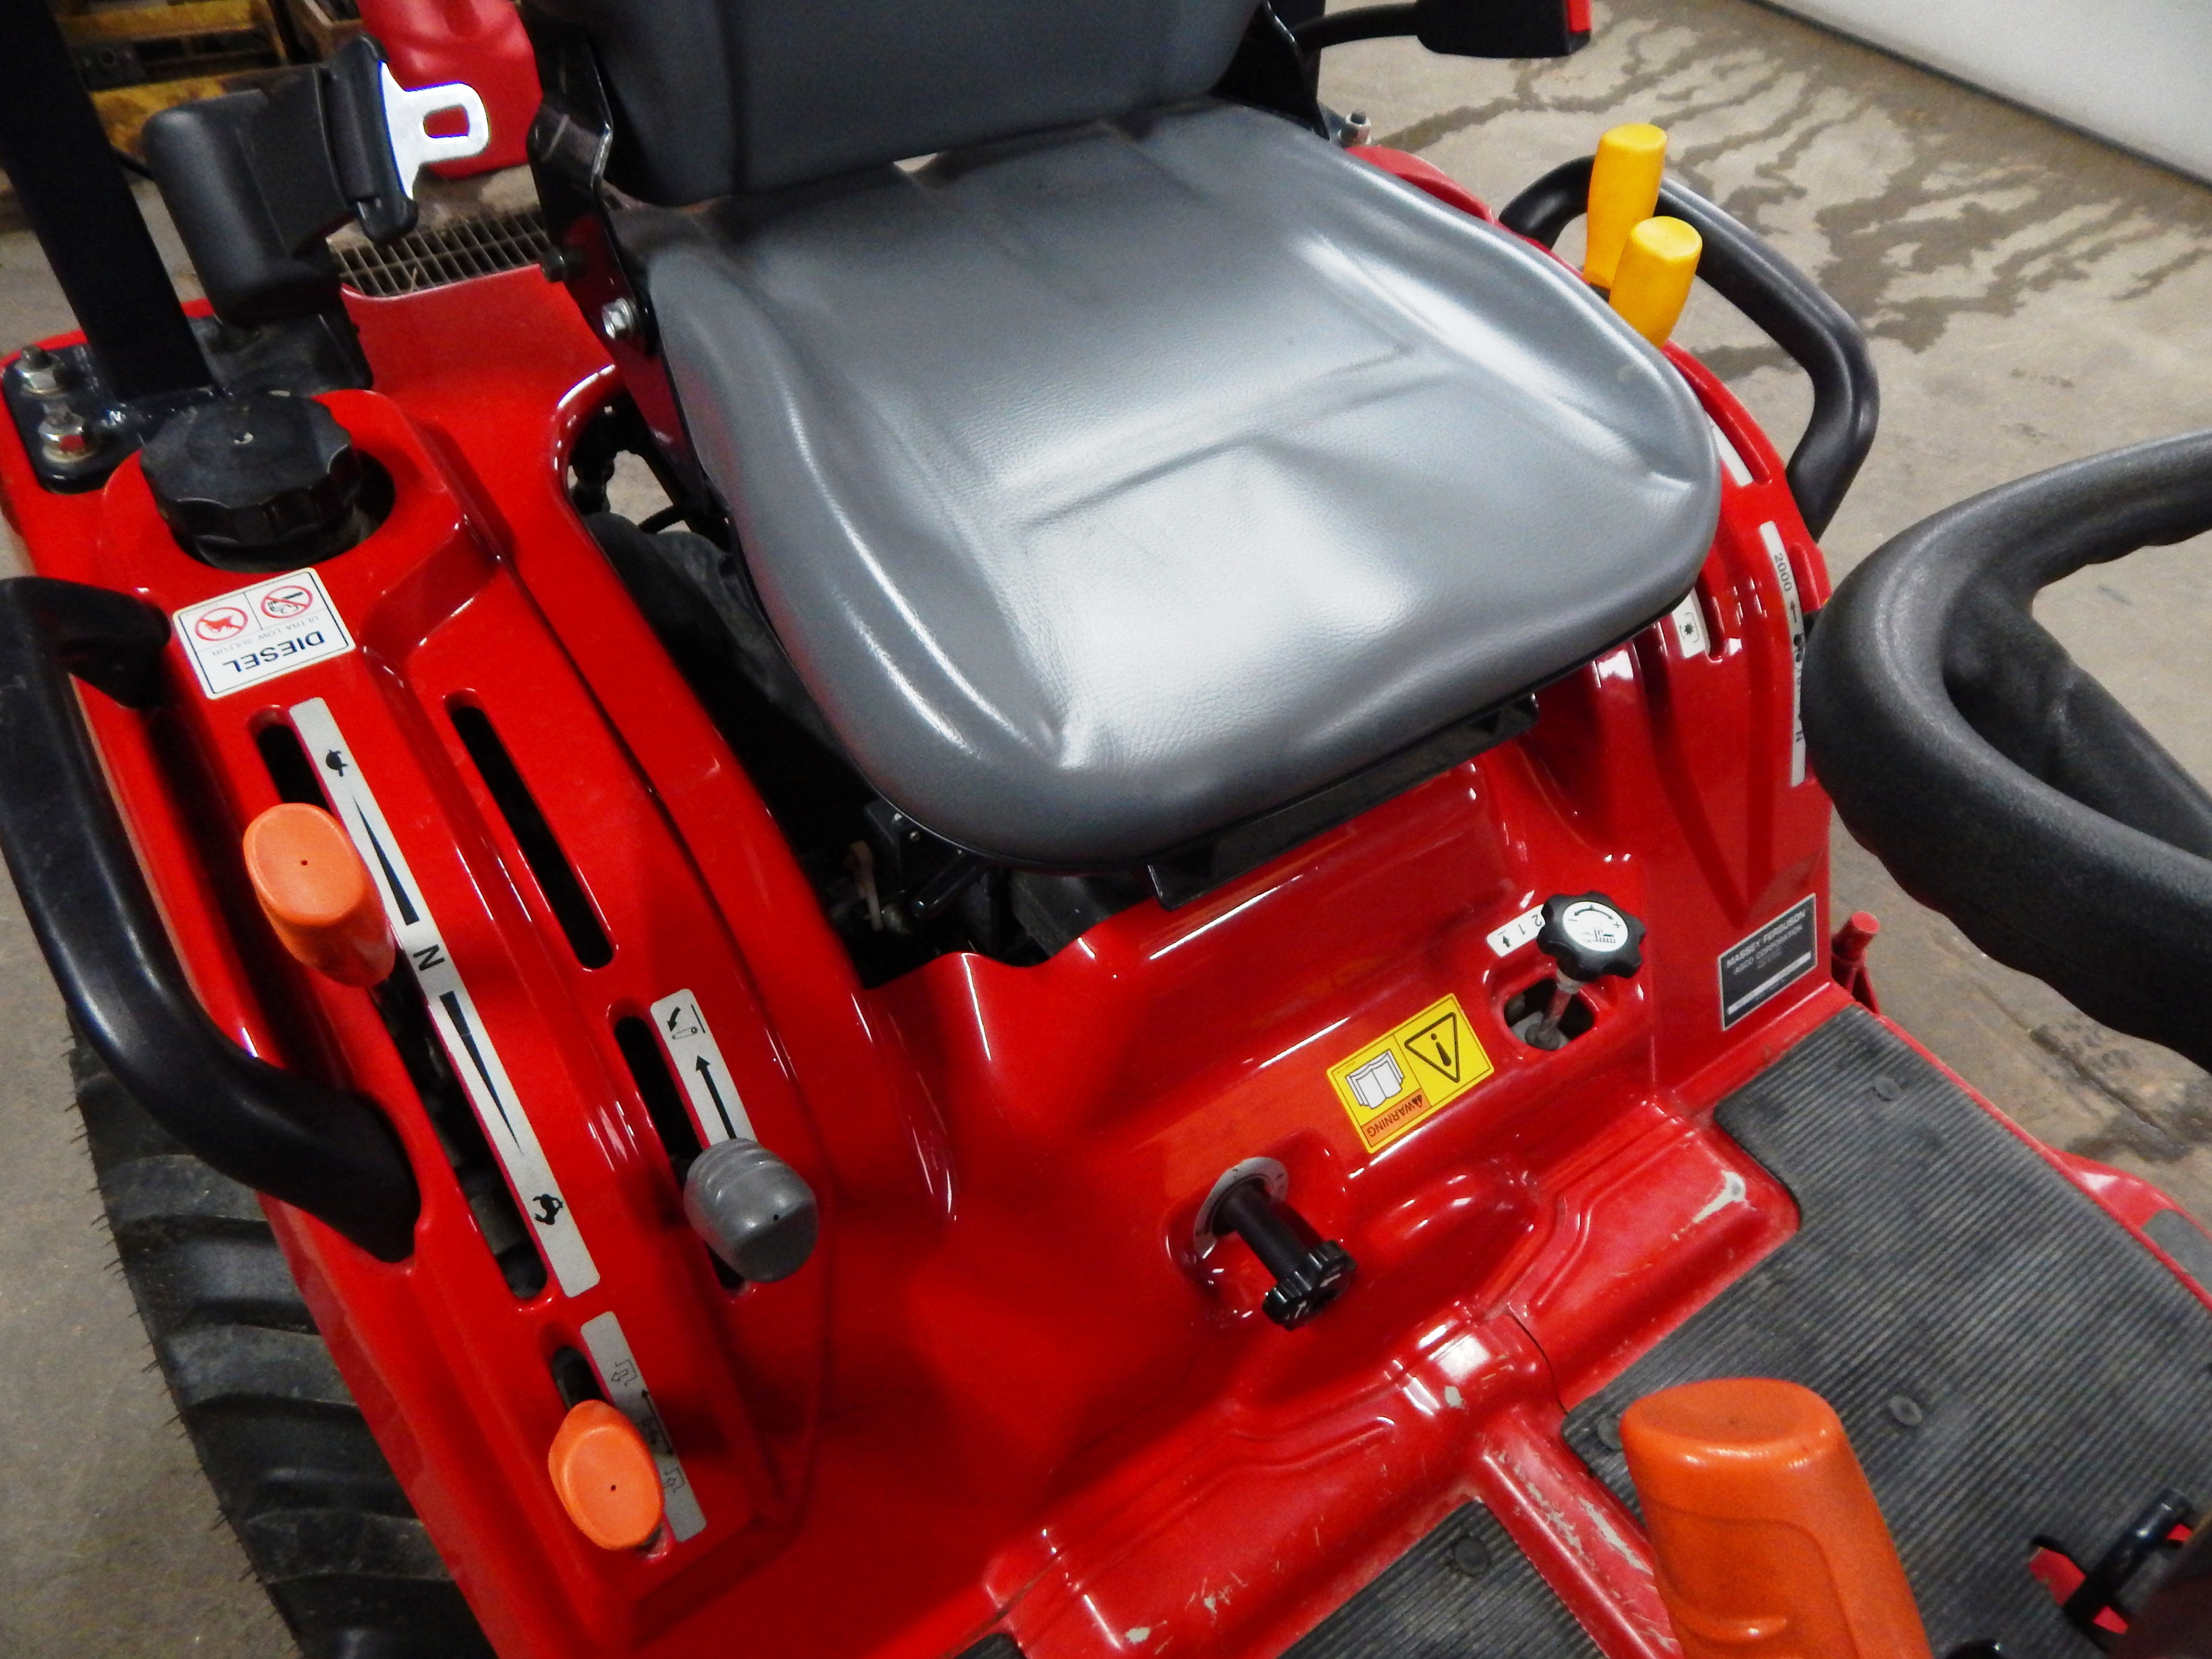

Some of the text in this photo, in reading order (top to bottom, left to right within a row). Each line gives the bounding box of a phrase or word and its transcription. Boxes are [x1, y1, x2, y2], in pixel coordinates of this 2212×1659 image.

[1773, 552, 1792, 592] 2000
[211, 615, 319, 656] ULTRA LOW SULFUR
[222, 630, 325, 673] DIESEL
[1531, 914, 1542, 927] 2
[413, 944, 445, 971] N
[1367, 1102, 1416, 1137] WARNING
